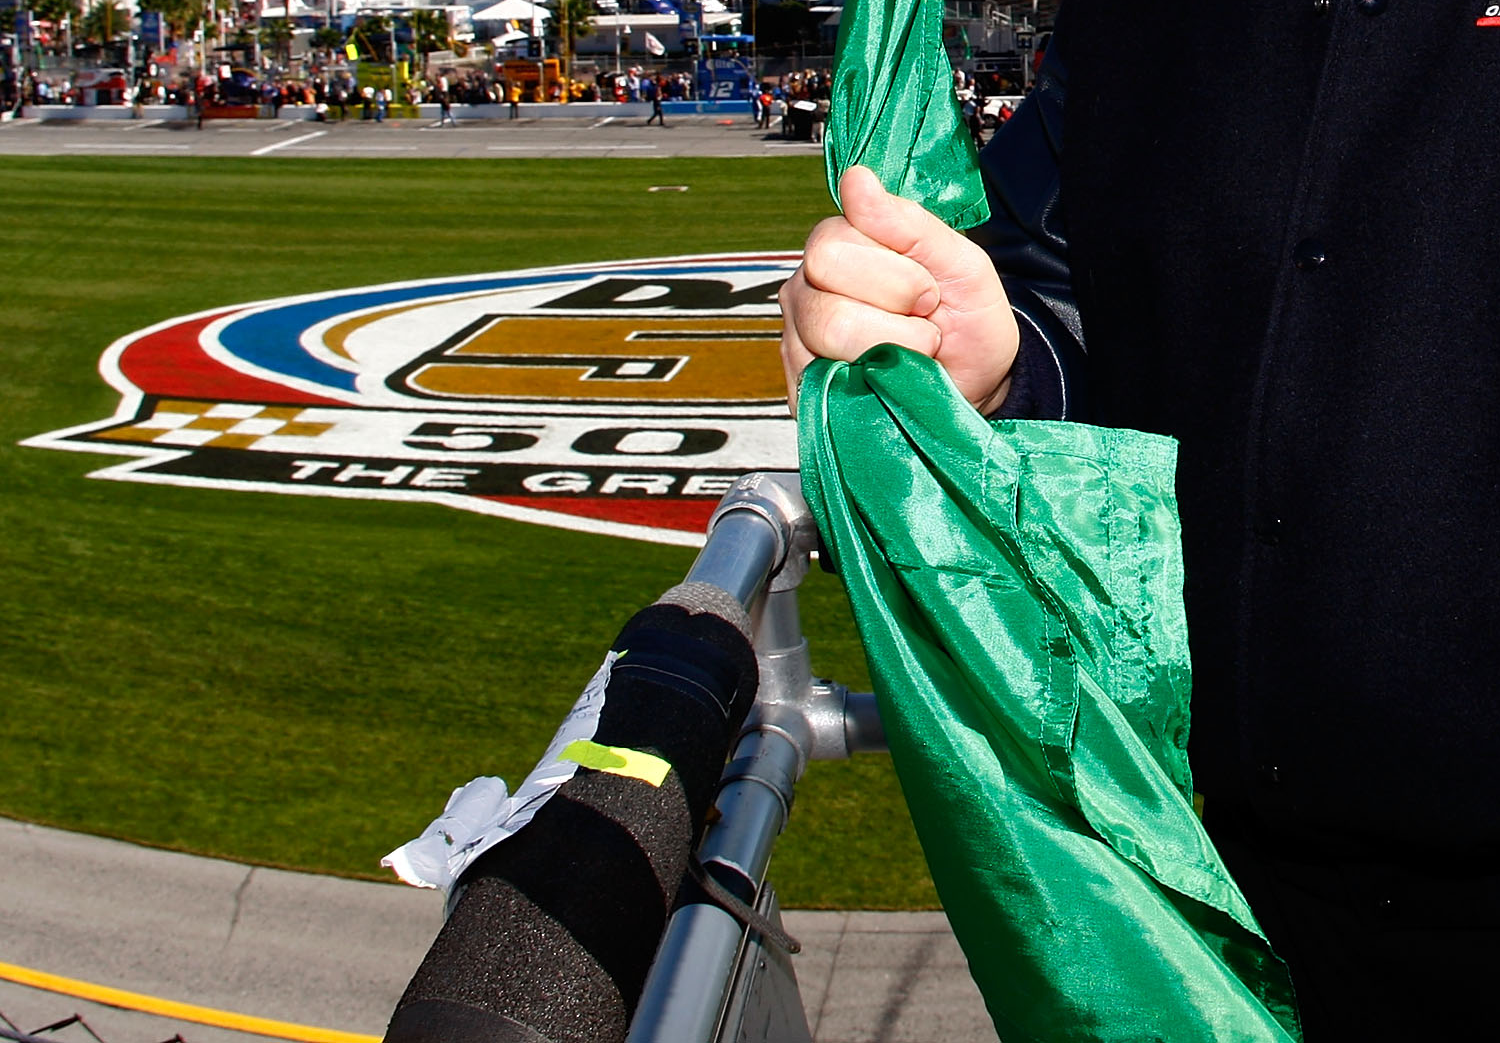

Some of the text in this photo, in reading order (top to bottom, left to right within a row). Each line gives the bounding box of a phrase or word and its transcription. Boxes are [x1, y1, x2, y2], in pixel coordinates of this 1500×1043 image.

[708, 80, 735, 98] 12
[402, 421, 729, 457] 50
[289, 459, 483, 491] THE
